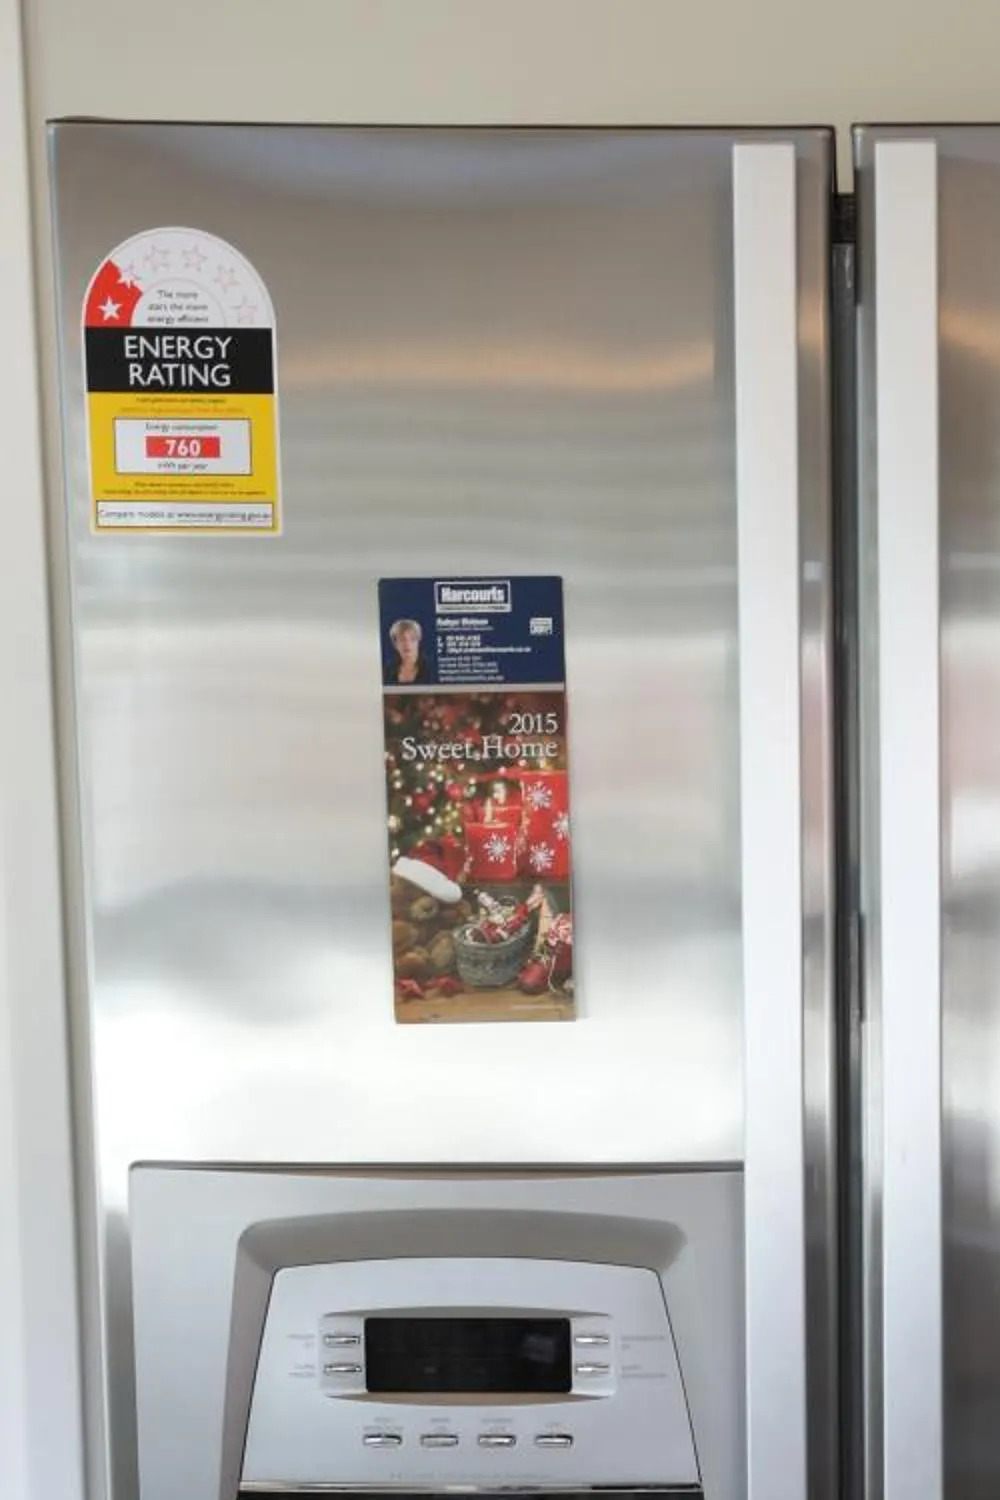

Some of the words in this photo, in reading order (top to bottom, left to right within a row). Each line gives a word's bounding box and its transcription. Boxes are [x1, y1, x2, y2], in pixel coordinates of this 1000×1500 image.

[124, 335, 233, 359] ENERGY
[128, 363, 231, 387] RATING
[165, 439, 201, 457] 760
[441, 586, 504, 603] Harcourts
[510, 713, 558, 734] 2015
[402, 736, 475, 760] Sweet
[481, 734, 558, 760] Home
